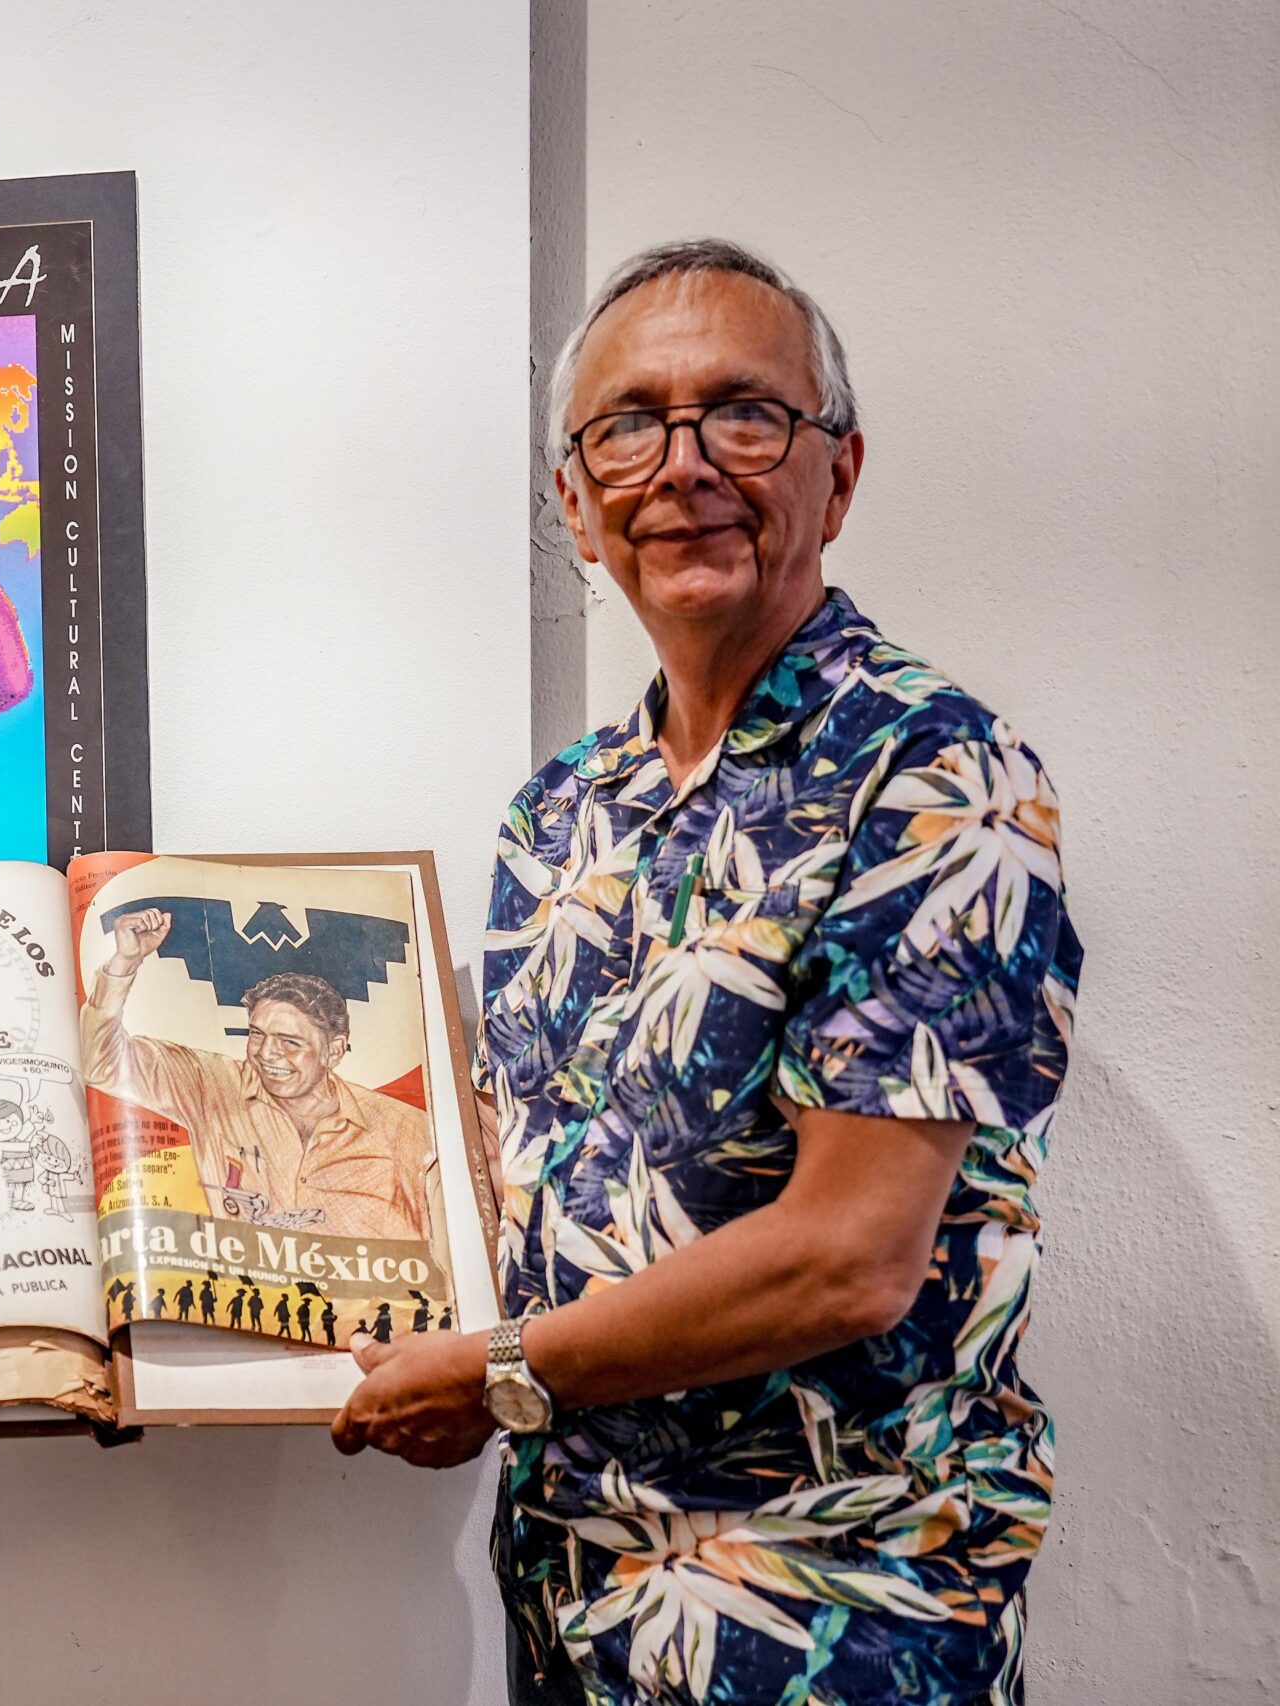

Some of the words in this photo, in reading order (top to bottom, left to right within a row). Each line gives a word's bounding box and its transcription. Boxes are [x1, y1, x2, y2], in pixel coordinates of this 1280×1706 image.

[60, 323, 78, 500] MISSION
[65, 521, 81, 721] CULTURAL
[70, 743, 84, 857] CENTE
[11, 926, 55, 978] LOS
[149, 1255, 209, 1271] EXPRESION
[211, 1263, 225, 1275] DE
[228, 1266, 246, 1277] UN
[247, 1269, 288, 1285] MUNDO
[189, 1221, 246, 1264] de
[256, 1231, 429, 1284] México
[10, 1278, 69, 1295] PUBLICA
